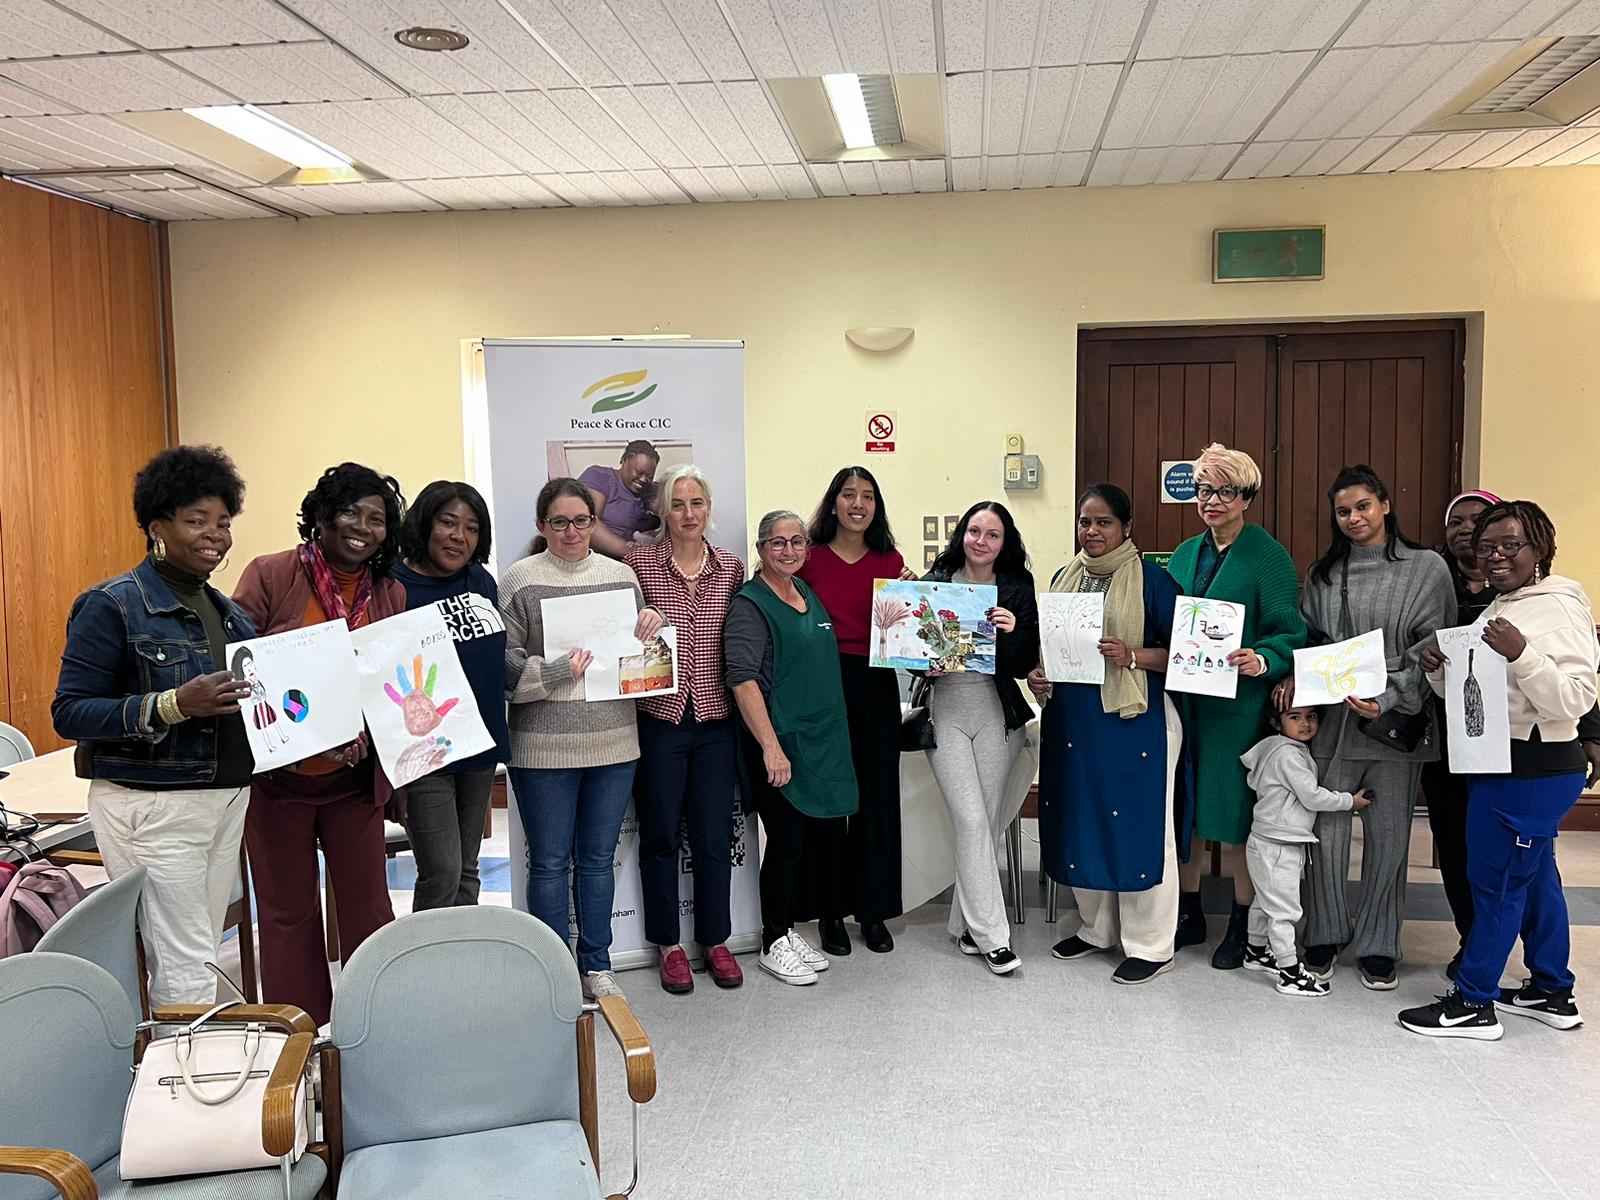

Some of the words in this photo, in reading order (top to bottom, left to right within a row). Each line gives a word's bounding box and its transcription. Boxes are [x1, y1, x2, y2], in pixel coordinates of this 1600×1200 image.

[570, 418, 601, 429] Peace
[603, 418, 614, 429] &
[615, 418, 647, 429] Grace
[648, 418, 672, 429] CIC
[434, 592, 470, 615] THE
[443, 607, 479, 627] RTH
[450, 621, 485, 642] ACE
[611, 909, 636, 918] nham
